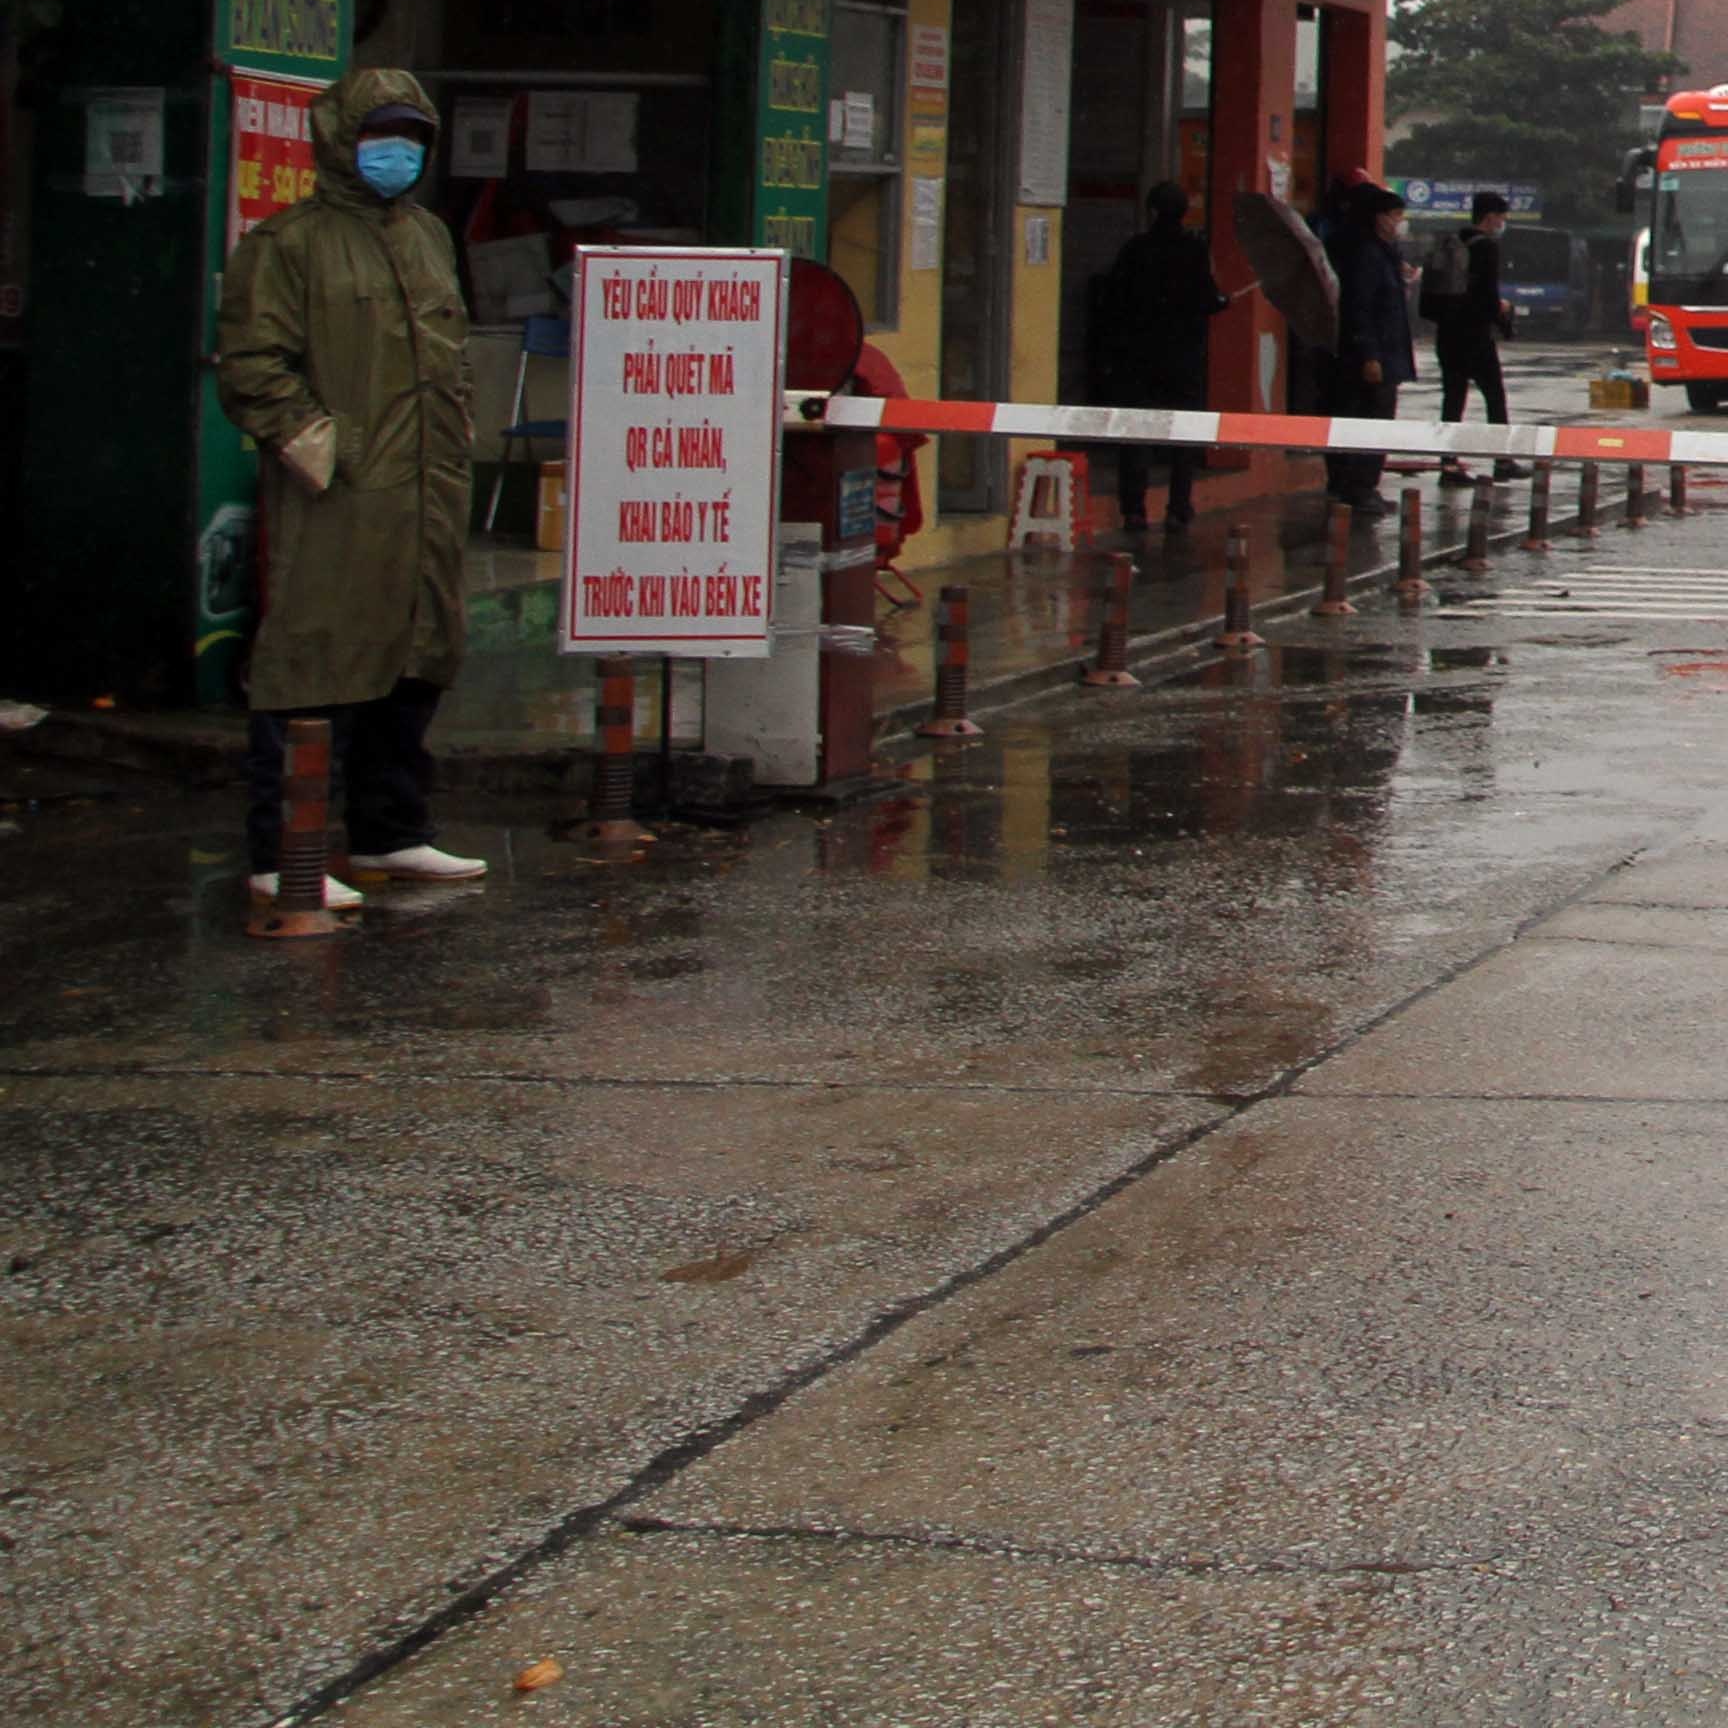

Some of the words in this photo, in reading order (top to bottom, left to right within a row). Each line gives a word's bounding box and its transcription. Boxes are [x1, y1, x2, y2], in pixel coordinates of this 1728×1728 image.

[601, 269, 632, 321] YÊU
[636, 264, 669, 320] CẦU
[672, 271, 704, 326] QUÝ
[707, 272, 761, 322] KHÁCH
[623, 338, 661, 395] PHẢI
[665, 346, 705, 400] QUÉT
[708, 345, 736, 395] MÃ
[625, 426, 648, 472] QR
[652, 418, 673, 470] CÁ
[677, 418, 728, 474] NHÂN,
[618, 501, 657, 543] KHAI
[660, 492, 693, 543] BÁO
[697, 501, 709, 543] Y
[711, 487, 732, 544] TẾ
[583, 566, 635, 618] TRƯỚC
[638, 575, 665, 617] KHI
[671, 567, 700, 618] VÀO
[704, 562, 738, 618] BẾN
[741, 575, 762, 618] XE
